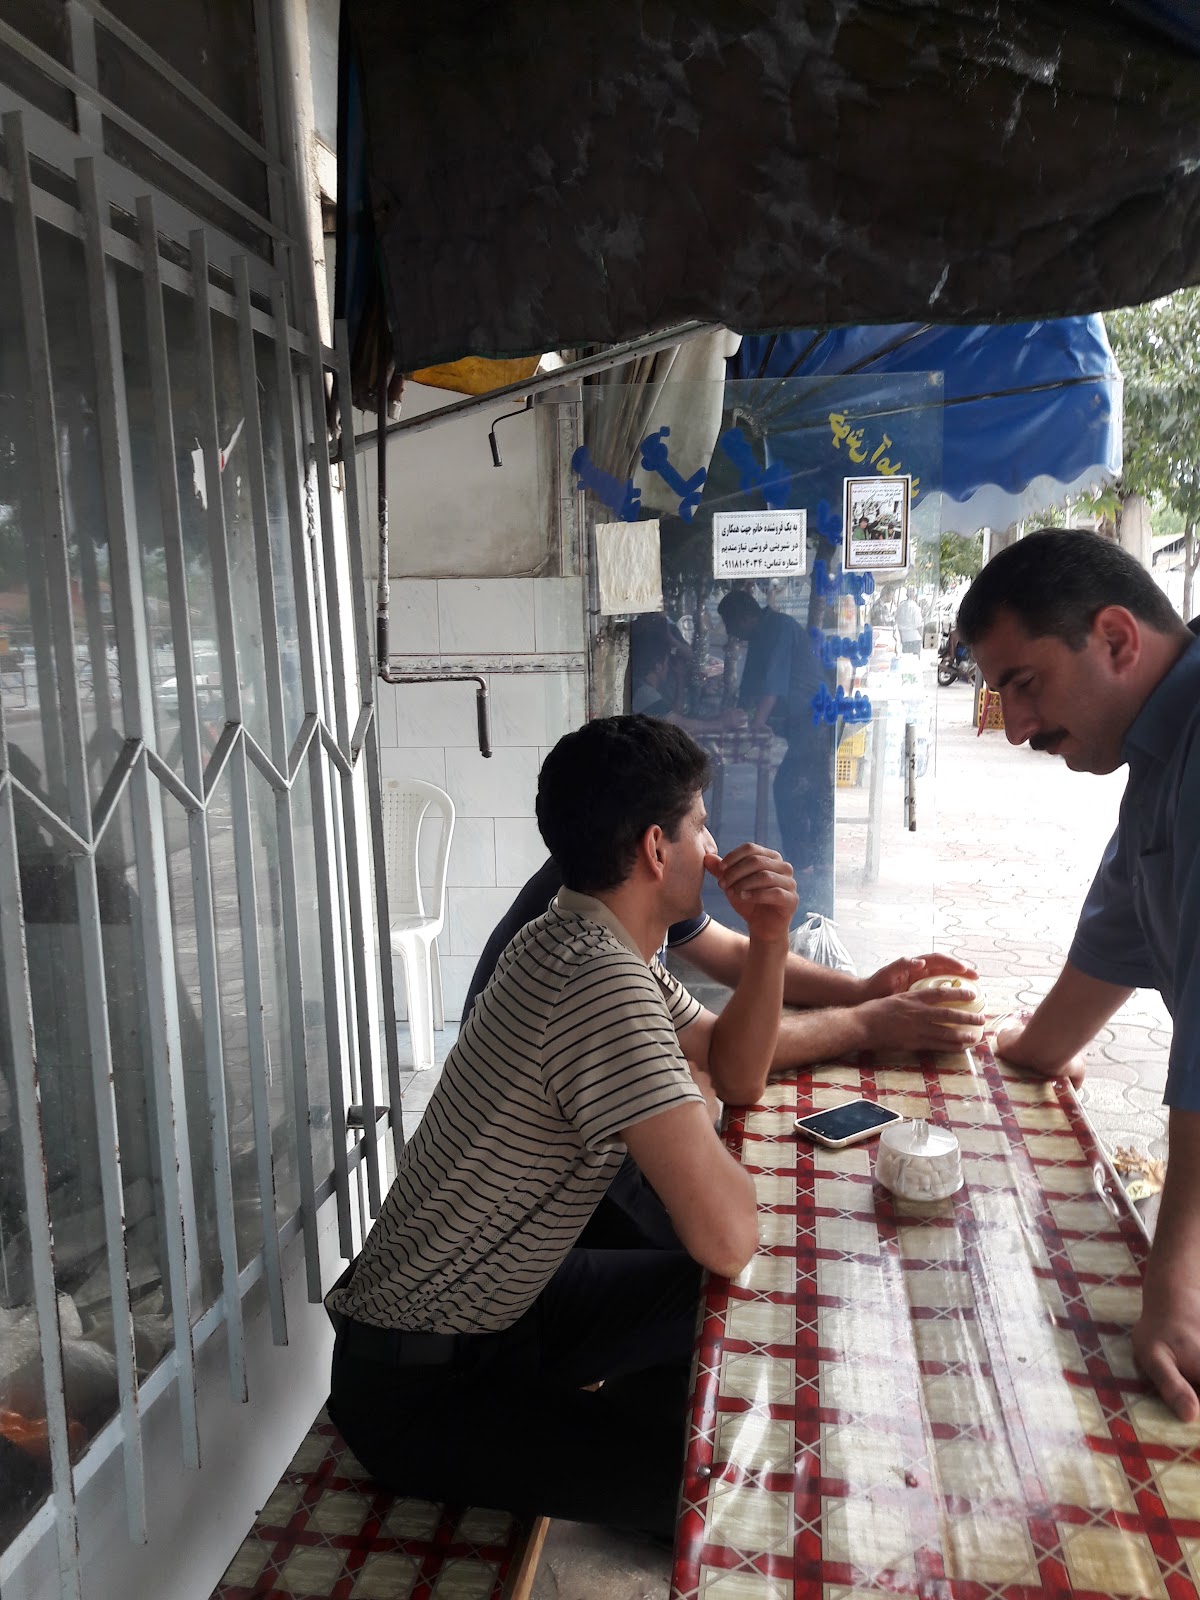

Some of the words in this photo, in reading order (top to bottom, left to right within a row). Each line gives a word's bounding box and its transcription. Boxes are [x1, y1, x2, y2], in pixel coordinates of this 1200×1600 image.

[721, 523, 740, 537] همکاری
[740, 525, 751, 536] جهت
[752, 523, 763, 536] خانم
[764, 521, 784, 535] فروشنده
[784, 522, 792, 534] یک
[792, 524, 798, 534] به
[748, 541, 768, 553] فروشی
[769, 541, 790, 552] شیرینی
[791, 542, 799, 551] در
[782, 558, 799, 569] شماره
